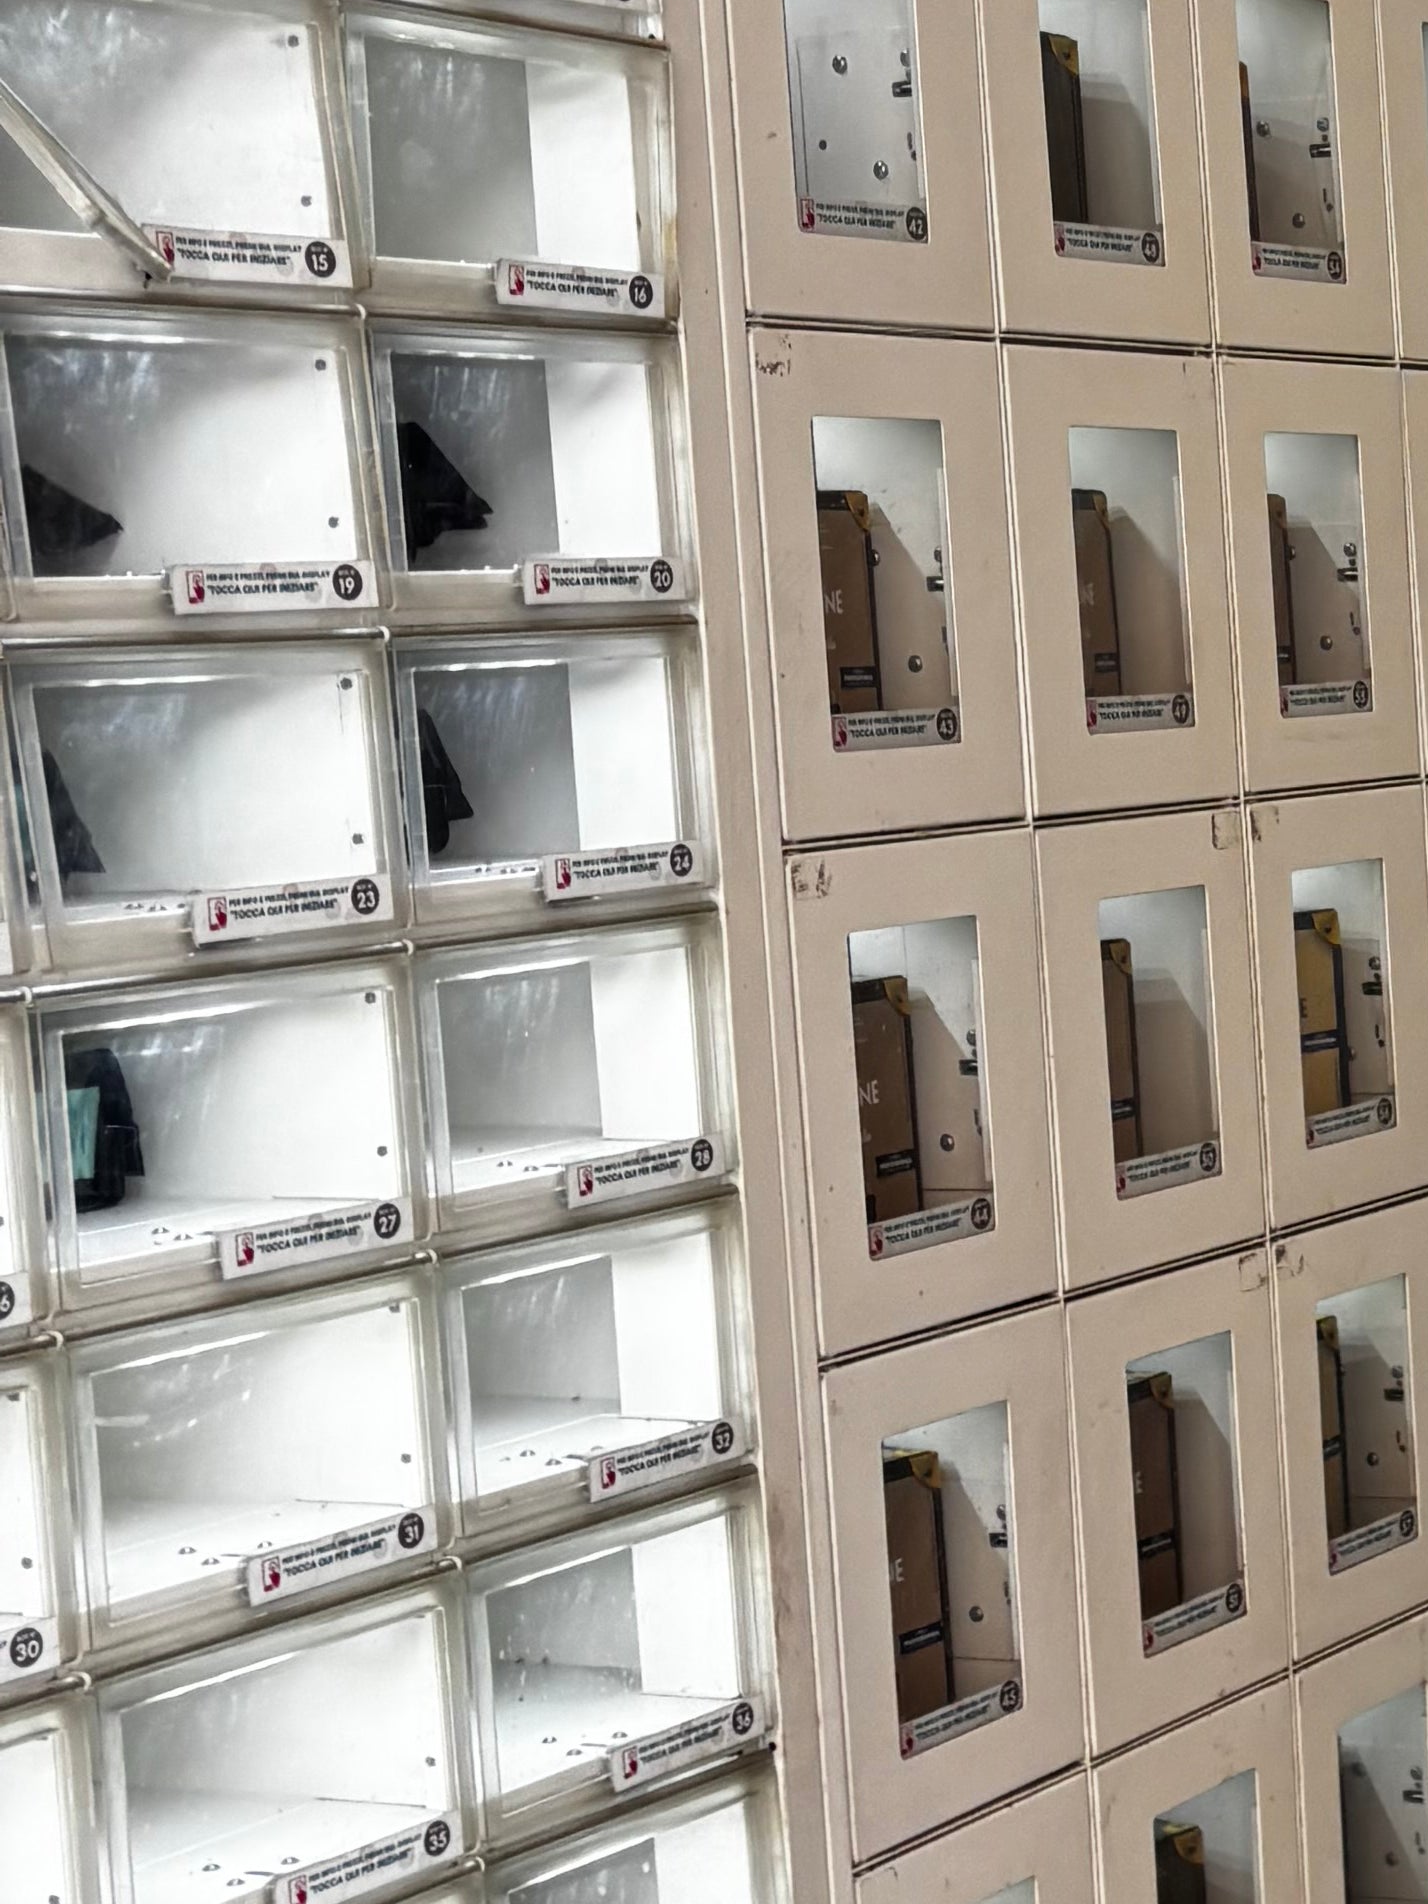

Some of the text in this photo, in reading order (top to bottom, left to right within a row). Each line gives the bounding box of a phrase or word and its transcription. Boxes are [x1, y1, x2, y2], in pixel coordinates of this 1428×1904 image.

[311, 254, 328, 271] 15
[634, 287, 646, 302] 16
[339, 577, 355, 593] 19
[654, 572, 670, 587] 20
[356, 890, 375, 909] 23
[379, 1214, 398, 1233] 27
[403, 1523, 419, 1543] 31
[15, 1640, 40, 1662] 30
